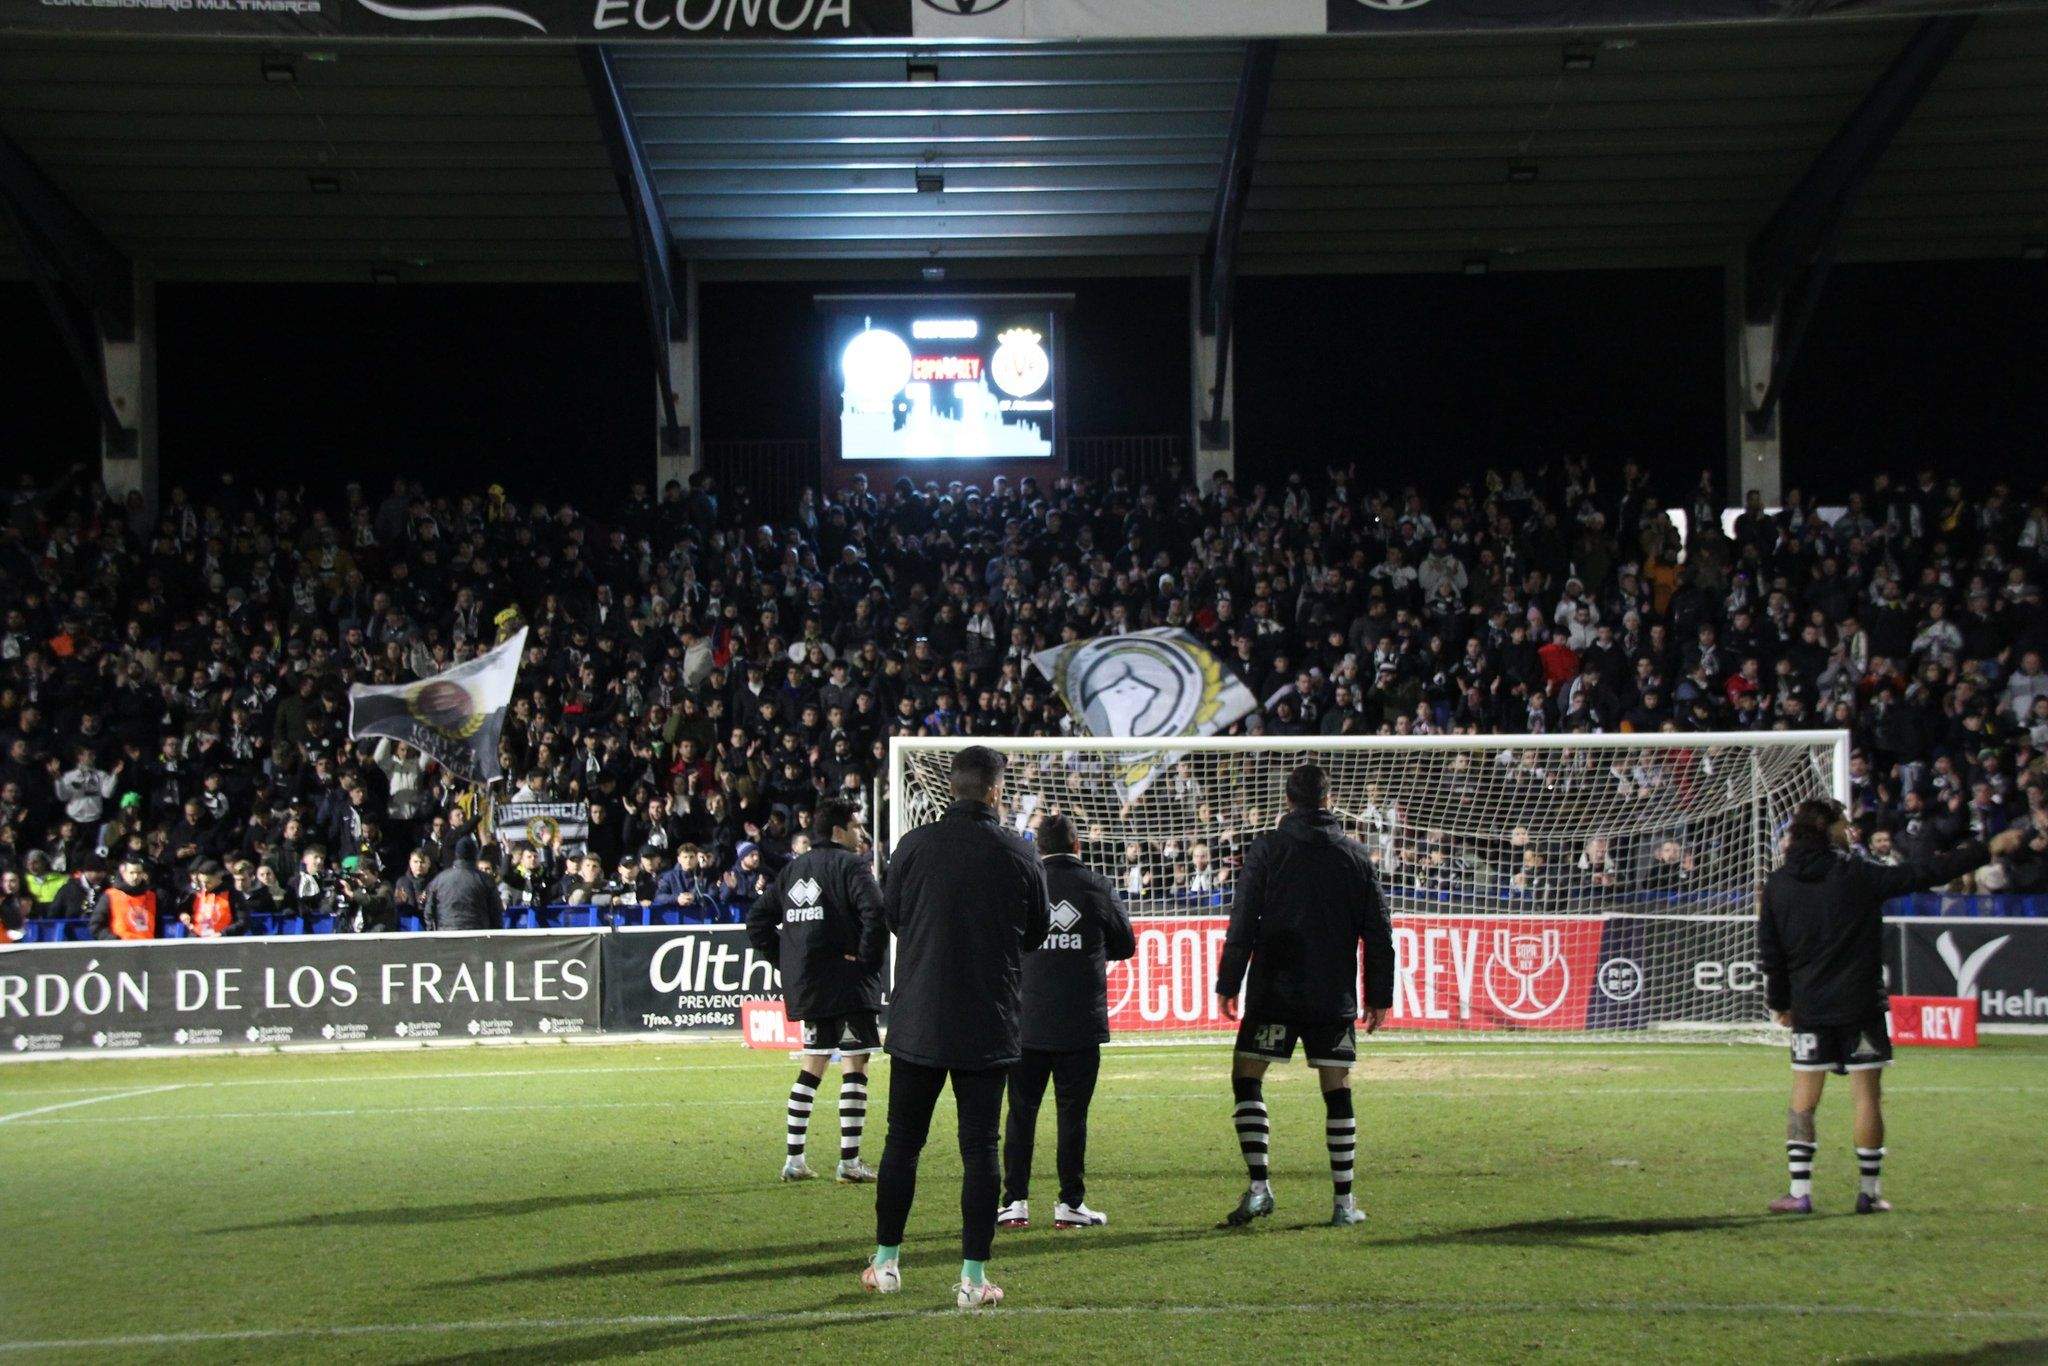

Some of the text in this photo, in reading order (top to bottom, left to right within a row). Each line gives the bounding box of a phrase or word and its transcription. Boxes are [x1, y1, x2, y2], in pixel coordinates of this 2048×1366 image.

[786, 906, 824, 922] errea
[176, 968, 243, 1011] DE
[265, 965, 358, 1008] LOS
[382, 959, 589, 1004] FRAILES
[1391, 928, 1479, 1020] REY
[750, 1010, 785, 1042] COPA
[1921, 1006, 1962, 1040] REY
